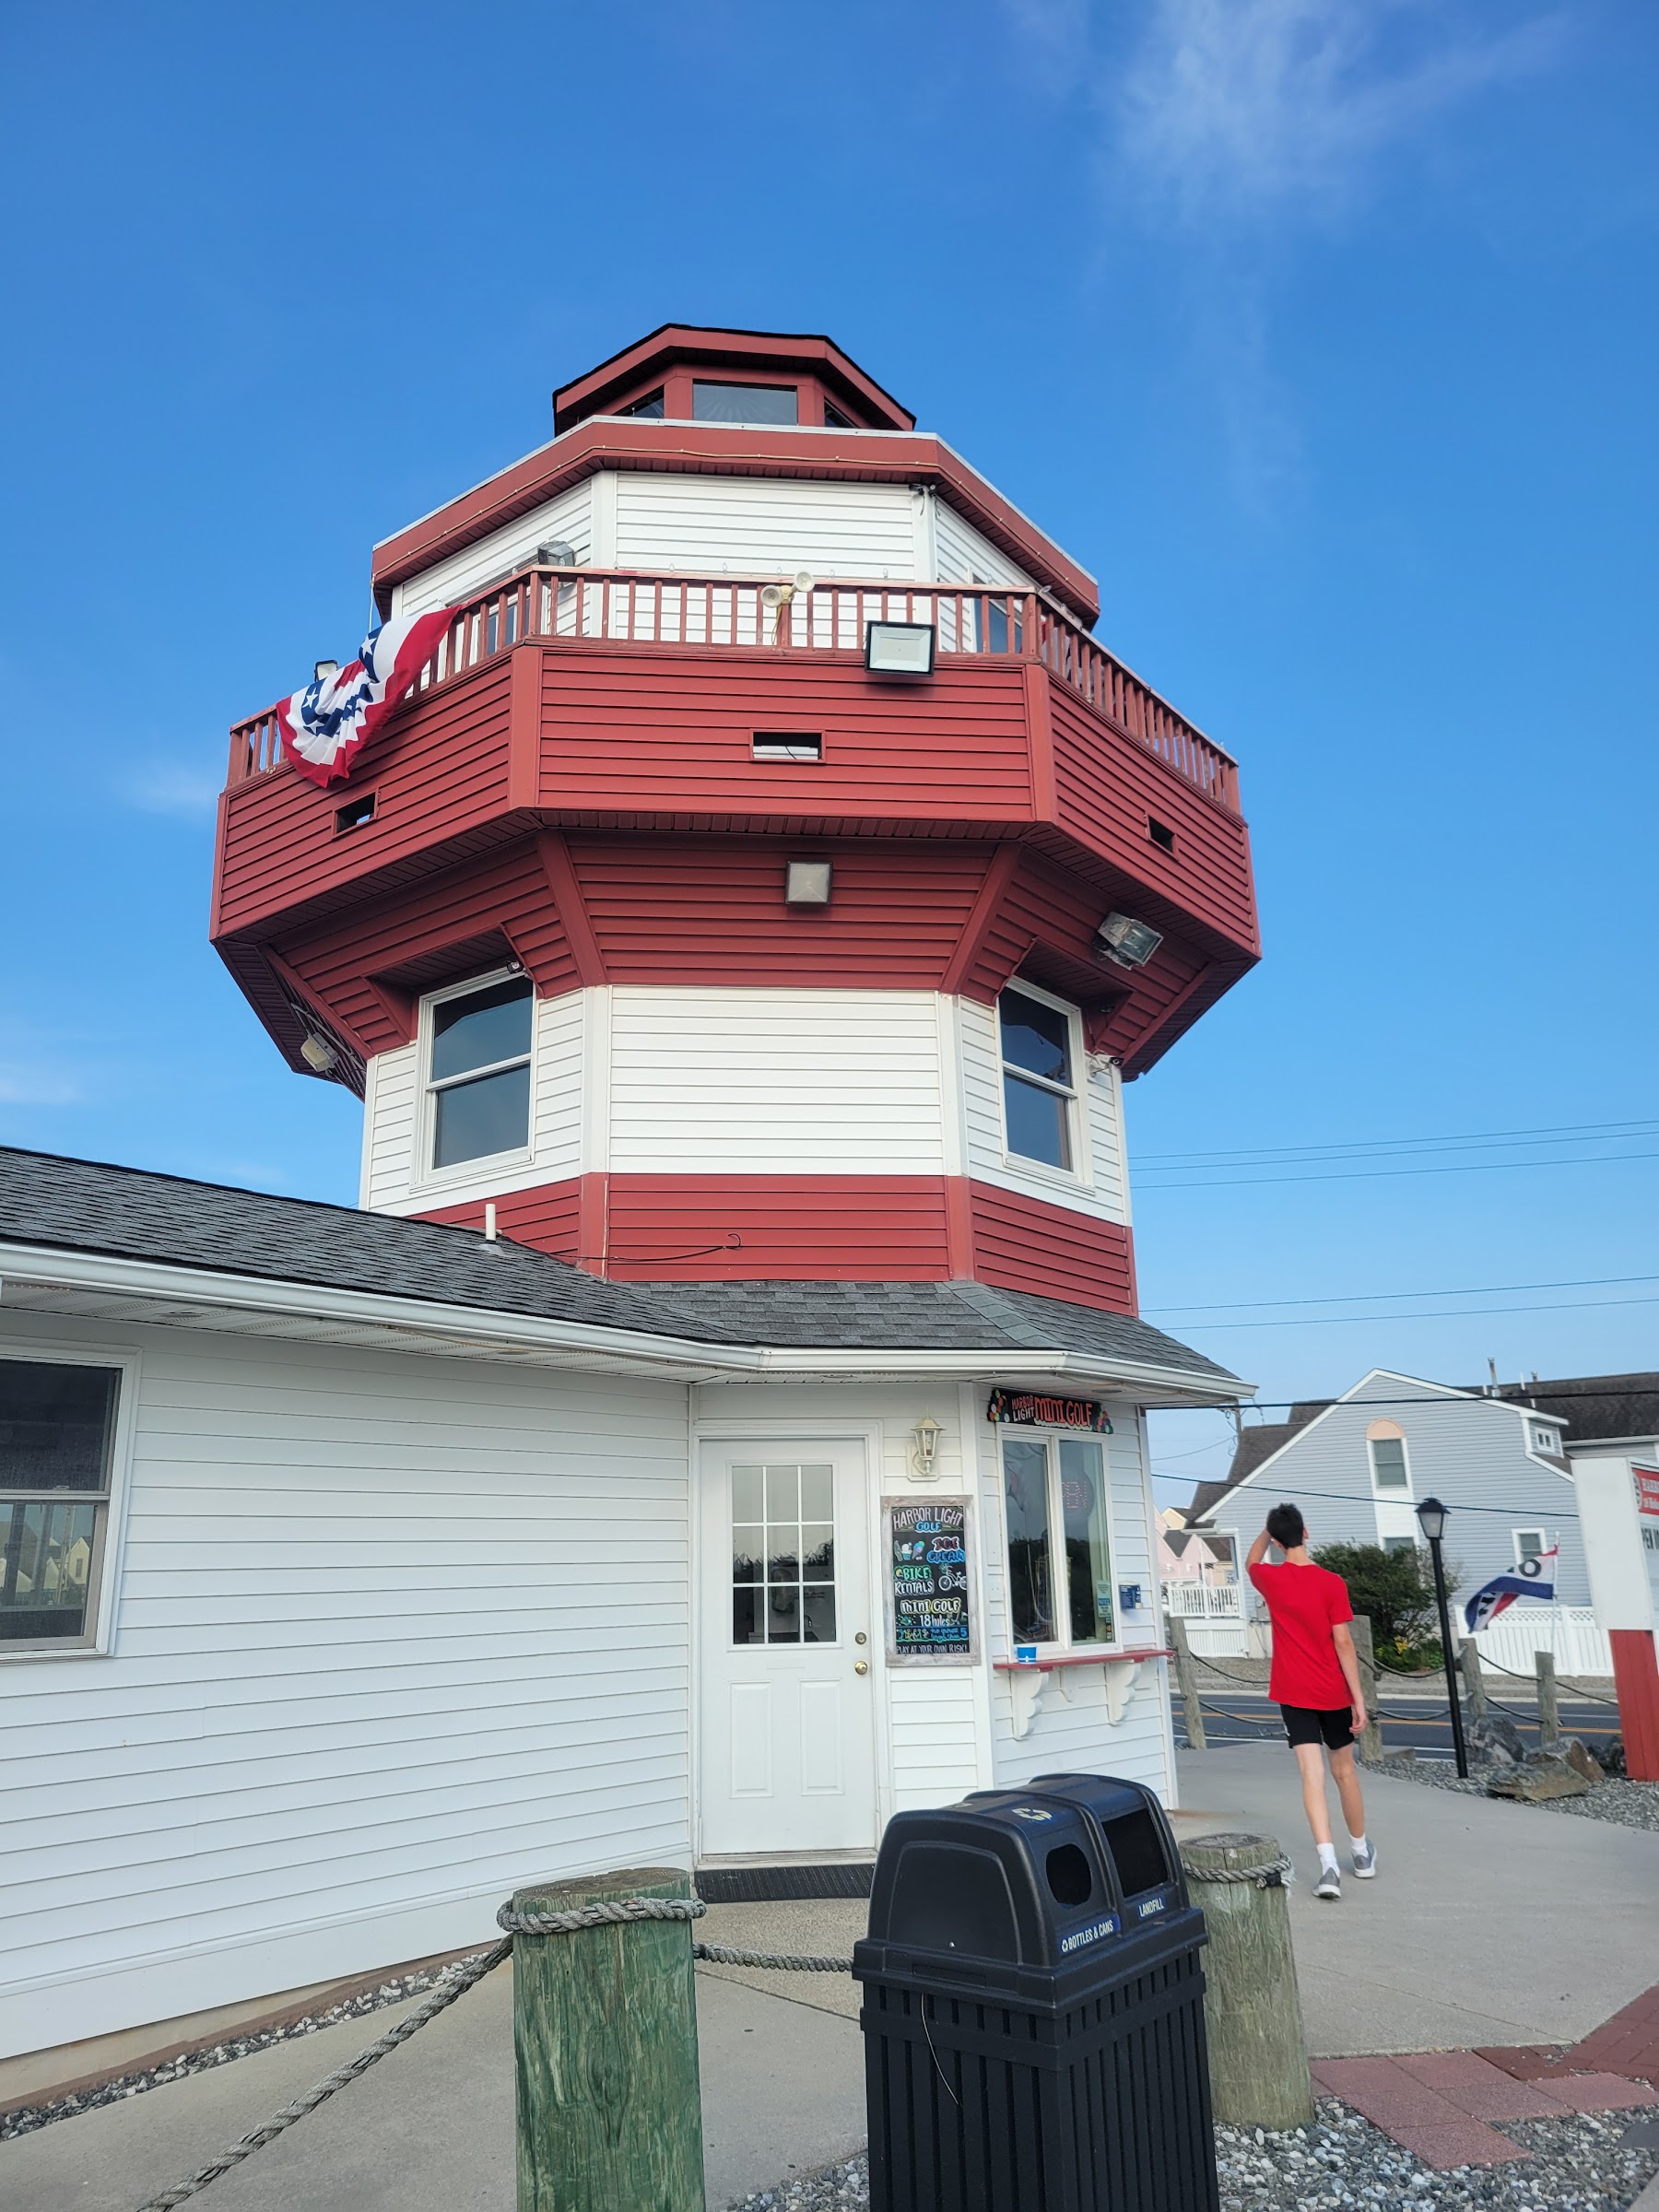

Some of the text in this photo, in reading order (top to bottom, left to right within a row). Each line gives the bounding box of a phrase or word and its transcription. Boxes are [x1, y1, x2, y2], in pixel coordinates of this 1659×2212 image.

[1012, 1394, 1033, 1410] HARBOR
[1013, 1407, 1034, 1422] LIGHT
[1034, 1396, 1092, 1426] MINI GOLF
[893, 1507, 963, 1530] HARBOR LIGHT
[916, 1521, 941, 1532] GOLF
[933, 1537, 959, 1551] ICE
[927, 1550, 965, 1562] CREAM
[903, 1567, 930, 1580] BIKE
[894, 1581, 933, 1594] RENTALS
[933, 1600, 959, 1612] GOLF
[920, 1614, 931, 1627] 18
[959, 1627, 968, 1638] 5
[896, 1643, 968, 1654] PLAY AT YOUR OWN RISK!
[1138, 1897, 1165, 1917] LANDFILL
[1067, 1919, 1113, 1950] BOTTLES & CANS
